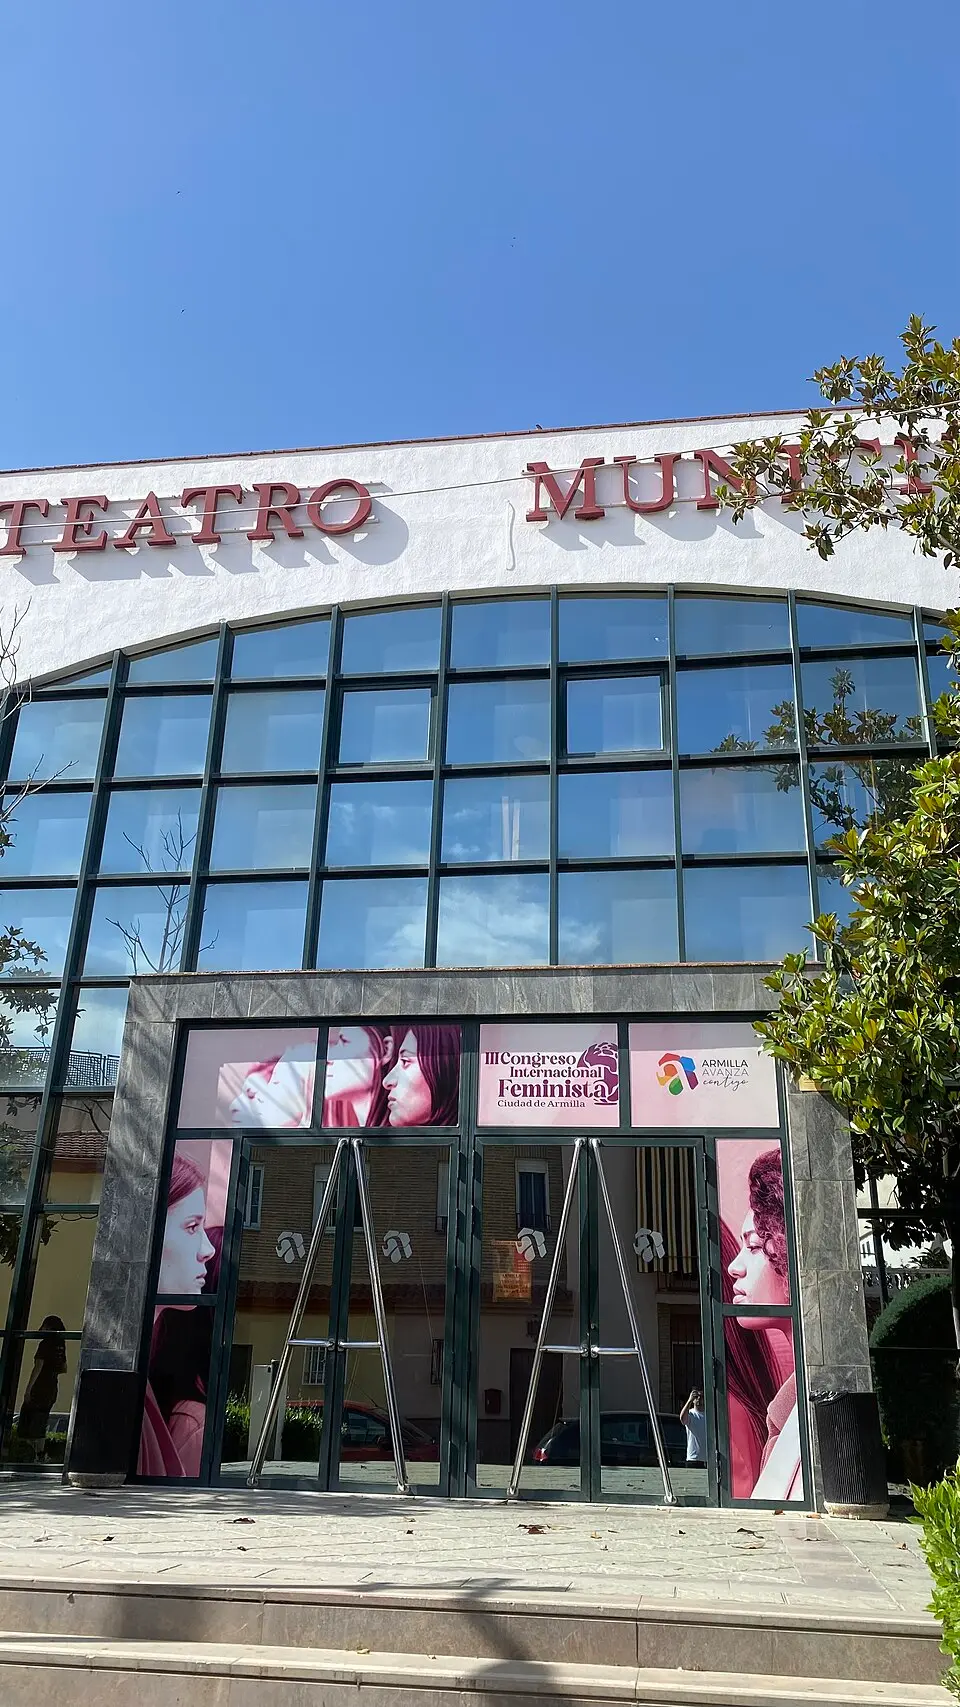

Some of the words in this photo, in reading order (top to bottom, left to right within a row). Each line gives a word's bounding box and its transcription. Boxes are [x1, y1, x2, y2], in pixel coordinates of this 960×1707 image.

[0, 478, 372, 556] TEATRO
[485, 1051, 499, 1065] III
[501, 1051, 577, 1068] Congreso
[702, 1059, 749, 1068] ARMILLA
[510, 1066, 602, 1078] Internacional
[702, 1068, 749, 1077] AVANZA
[498, 1079, 607, 1099] Feminista
[702, 1074, 749, 1092] contigo
[497, 1099, 534, 1108] Ciudad
[536, 1099, 546, 1108] de
[547, 1099, 586, 1108] Armilla
